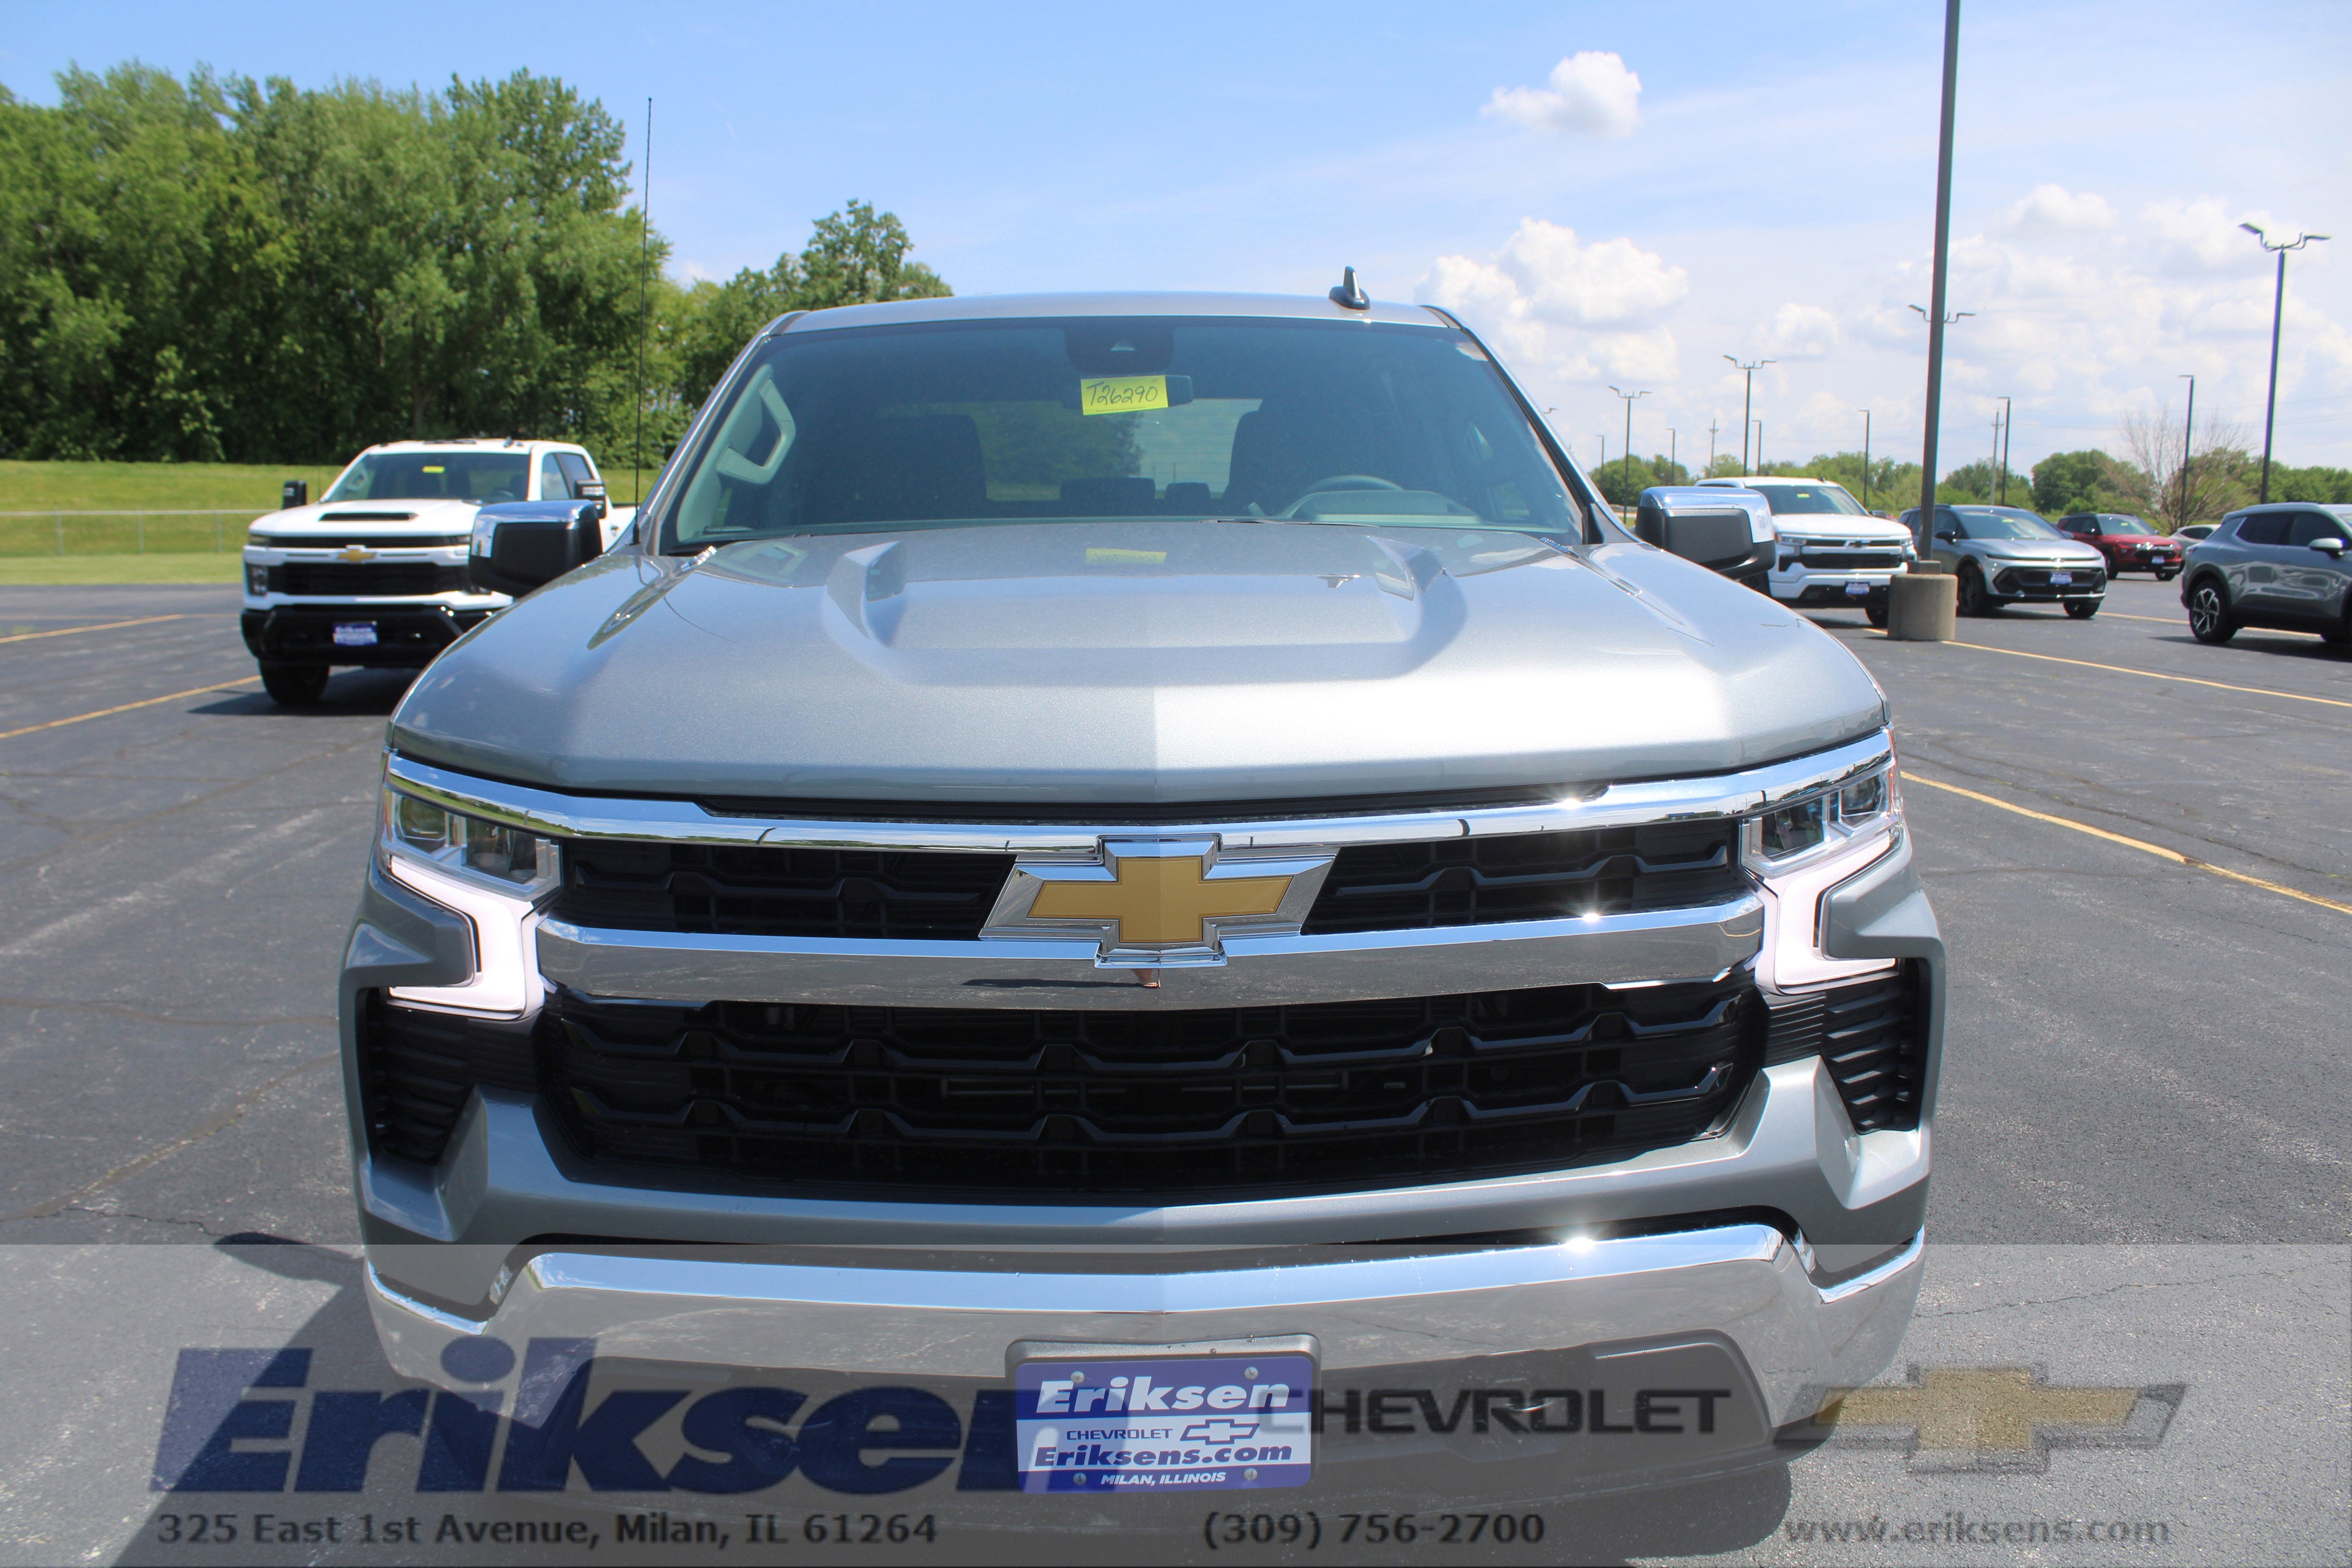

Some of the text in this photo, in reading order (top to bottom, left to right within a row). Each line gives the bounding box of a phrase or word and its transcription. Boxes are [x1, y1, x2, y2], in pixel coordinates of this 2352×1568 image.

[1086, 381, 1158, 406] T26290
[1036, 1376, 1291, 1414] Eriksen
[1066, 1428, 1173, 1440] CHEVROLET
[1034, 1443, 1292, 1467] Eriksens.com
[1100, 1472, 1227, 1486] MILAN, ILLINOIS
